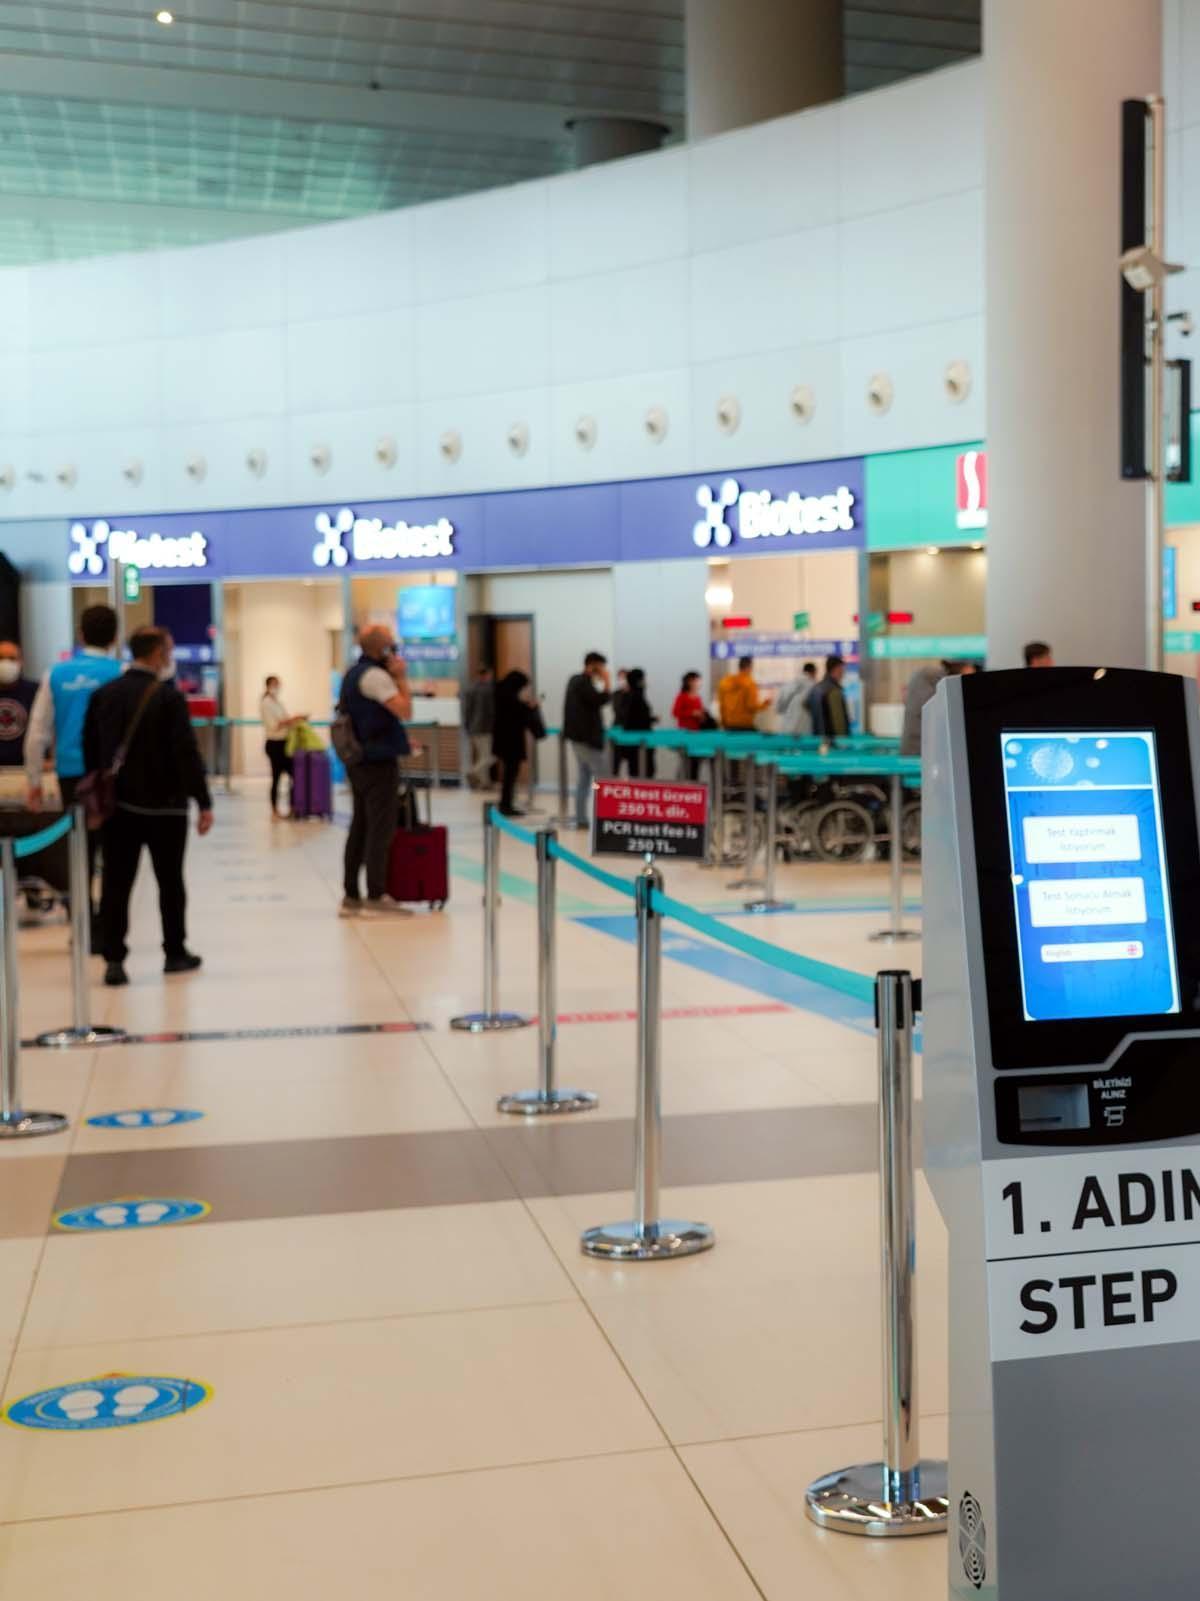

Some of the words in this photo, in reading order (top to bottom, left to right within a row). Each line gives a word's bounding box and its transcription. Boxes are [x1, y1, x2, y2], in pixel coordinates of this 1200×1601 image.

[739, 486, 854, 539] Biotest
[108, 530, 207, 568] Biotest
[353, 518, 454, 560] Biotest
[603, 785, 631, 799] PCR
[634, 789, 659, 799] test
[662, 790, 703, 803] ücreti
[618, 802, 645, 816] 250
[646, 804, 663, 817] TL
[665, 805, 690, 818] dir.
[603, 821, 632, 834] PCR
[634, 825, 660, 836] test
[661, 824, 685, 838] fee
[686, 825, 698, 839] is
[627, 838, 654, 851] 250
[1003, 1181, 1051, 1235] 1.
[1019, 1268, 1178, 1334] STEP
